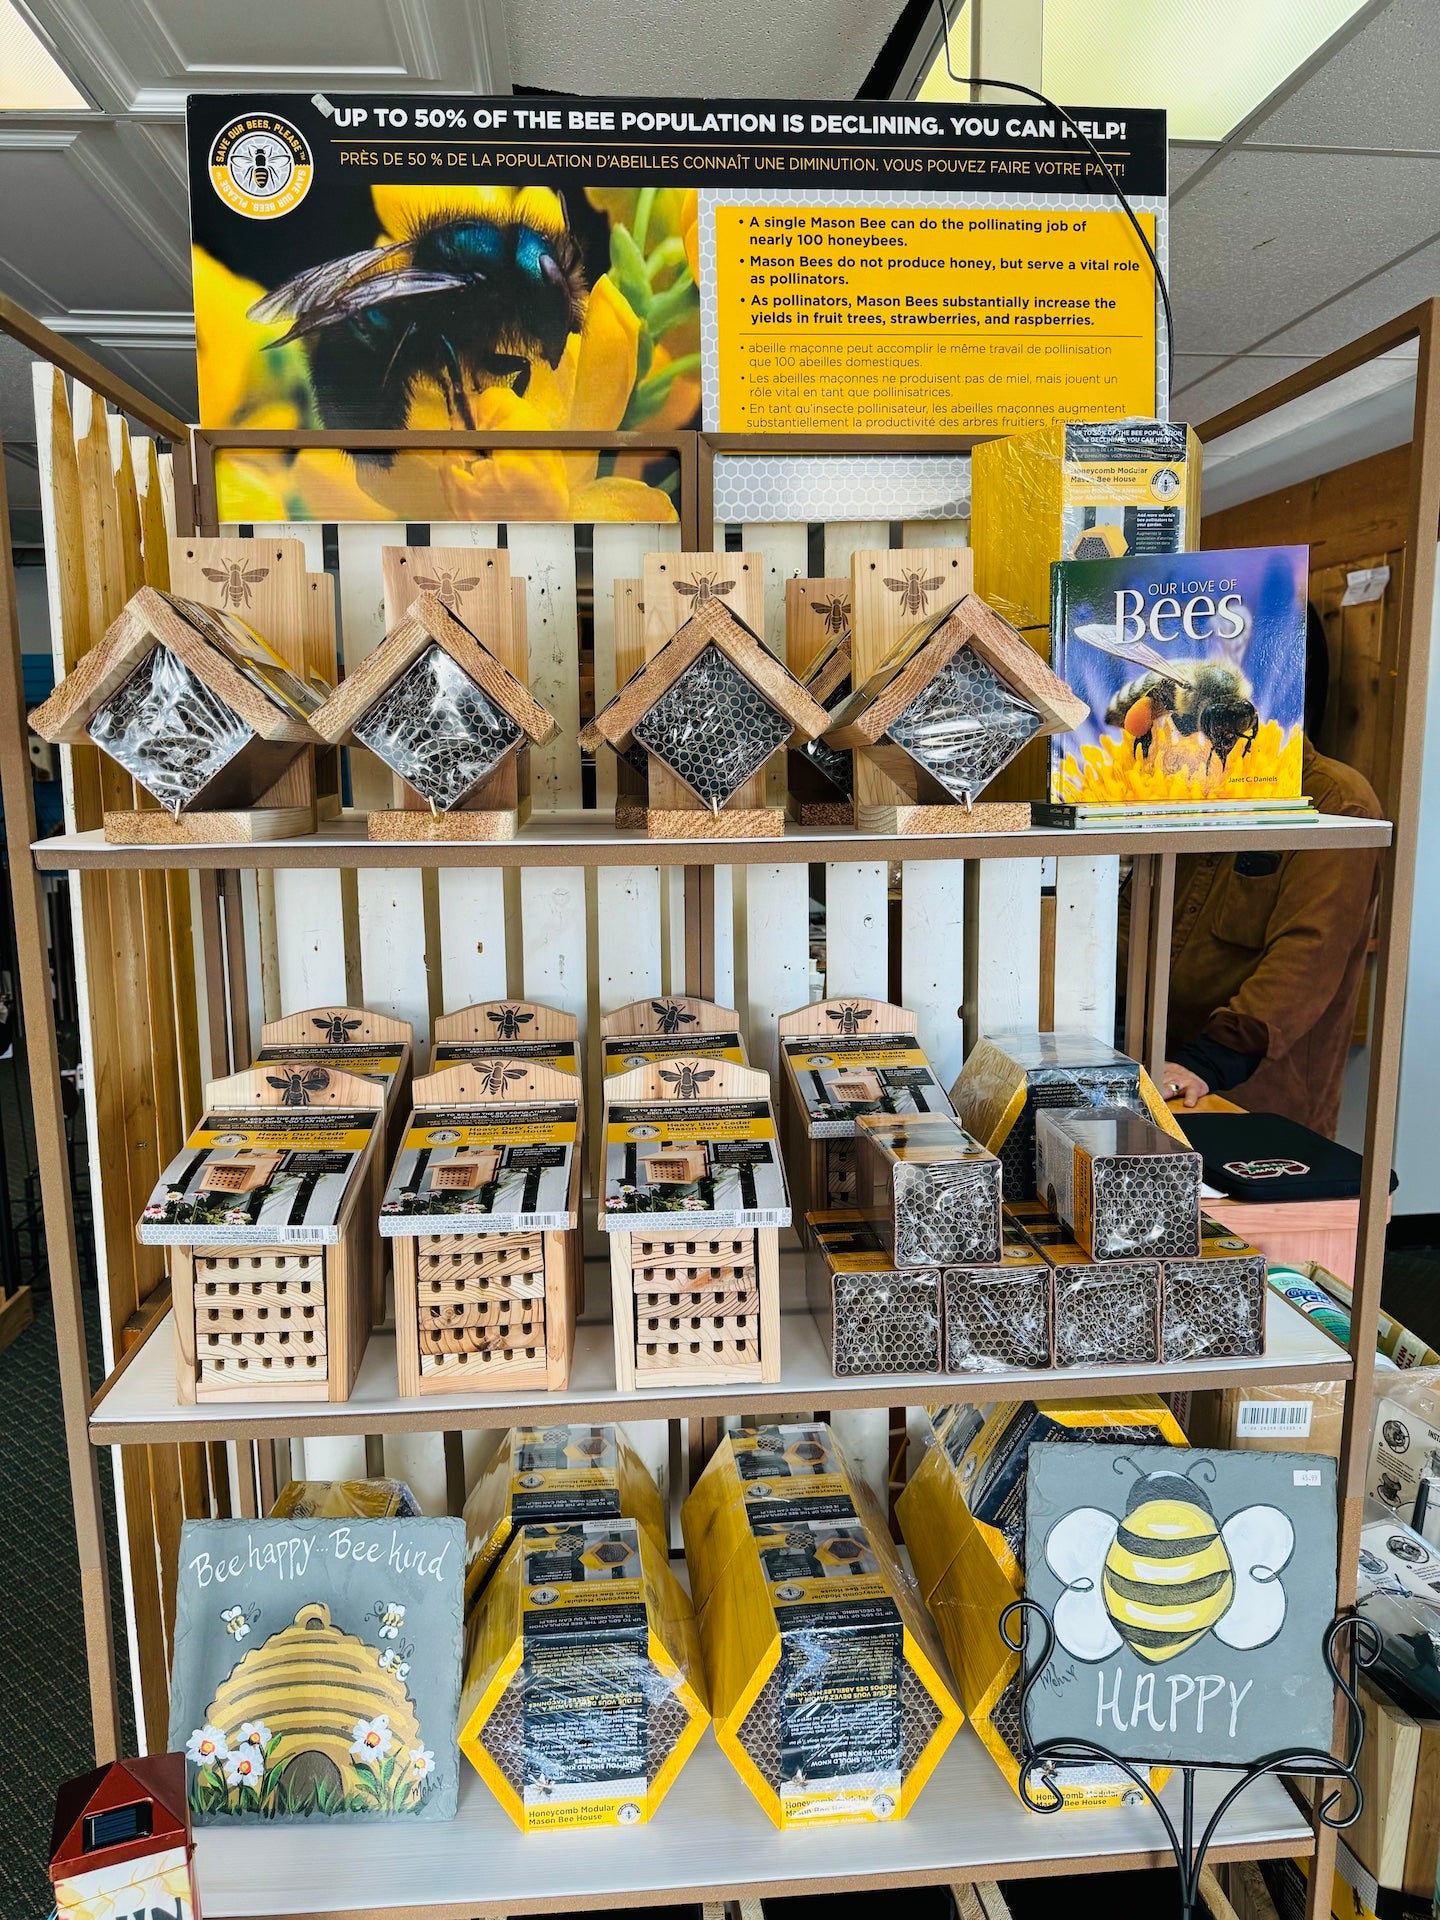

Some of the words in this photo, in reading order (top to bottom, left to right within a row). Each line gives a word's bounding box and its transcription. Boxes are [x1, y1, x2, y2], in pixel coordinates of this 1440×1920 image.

[334, 108, 367, 127] UP
[374, 109, 408, 127] TO
[415, 109, 466, 128] 50%
[474, 110, 507, 128] OF
[514, 111, 562, 129] THE
[569, 112, 614, 130] BEE
[622, 112, 775, 132] POPULATION
[783, 115, 804, 132] IS
[811, 115, 944, 134] DECLINING.
[950, 118, 999, 136] YOU
[1006, 119, 1054, 137] CAN
[1062, 121, 1126, 140] HELP!
[216, 138, 230, 162] SAVE
[228, 124, 245, 139] OUR
[246, 120, 271, 129] BEES.
[341, 150, 378, 165] PRÈS
[384, 152, 403, 165] DE
[408, 153, 426, 165] 50
[431, 153, 442, 166] %
[448, 153, 467, 166] DE
[472, 154, 491, 166] LA
[496, 154, 591, 167] POPULATION
[684, 154, 750, 169] CONNAÎT
[755, 157, 784, 170] UNE
[790, 158, 878, 171] DIMINUTION.
[883, 159, 923, 172] VOUS
[928, 160, 986, 172] POUVEZ
[991, 161, 1030, 174] FAIRE
[1035, 162, 1081, 175] VOTRE
[1085, 163, 1124, 176] PART!
[750, 217, 759, 227] A
[765, 216, 806, 229] single
[812, 218, 854, 228] Mason
[861, 218, 886, 228] Bee
[920, 218, 937, 229] do
[942, 219, 964, 229] the
[969, 219, 1042, 232] pollinating
[1047, 220, 1068, 233] job
[1073, 221, 1086, 231] of
[750, 234, 792, 247] nearly
[798, 235, 822, 245] 100
[828, 234, 907, 248] honeybees.
[751, 256, 794, 266] Mason
[800, 256, 832, 267] Bees
[838, 256, 855, 267] do
[861, 258, 882, 267] not
[888, 257, 944, 269] produce
[950, 258, 995, 270] honey,
[1001, 258, 1022, 268] but
[1028, 261, 1063, 269] serve
[1069, 262, 1075, 270] a
[1081, 260, 1108, 270] vital
[1114, 260, 1139, 271] role
[751, 276, 764, 284] as
[770, 273, 848, 286] pollinators.
[751, 295, 768, 305] As
[774, 295, 851, 308] pollinators,
[857, 296, 900, 306] Mason
[906, 296, 938, 306] Bees
[943, 296, 1029, 309] substantially
[1035, 297, 1090, 308] increase
[1095, 298, 1116, 308] the
[752, 312, 792, 325] yields
[798, 312, 808, 323] in
[814, 312, 842, 323] fruit
[848, 314, 885, 325] trees,
[891, 313, 980, 326] strawberries,
[985, 314, 1009, 324] and
[1015, 314, 1094, 326] raspberries.
[749, 343, 786, 353] abeille
[790, 345, 843, 354] maçonne
[848, 344, 873, 354] peut
[877, 344, 933, 354] accomplir
[938, 344, 946, 353] le
[951, 344, 986, 353] même
[990, 344, 1023, 354] travail
[1027, 344, 1041, 354] de
[1045, 344, 1111, 355] pollinisation
[750, 359, 771, 368] que
[775, 357, 795, 366] 100
[799, 357, 842, 366] abeilles
[846, 357, 922, 368] domestiques.
[750, 374, 769, 383] Les
[773, 373, 815, 383] abeilles
[820, 376, 878, 384] maçonnes
[900, 373, 960, 384] produisent
[965, 376, 984, 384] pas
[988, 374, 1002, 383] de
[1006, 374, 1031, 384] miel,
[1036, 374, 1061, 383] mais
[1065, 374, 1100, 385] jouent
[1104, 376, 1117, 384] un
[750, 387, 772, 397] rôle
[776, 387, 799, 397] vital
[804, 389, 817, 397] en
[822, 388, 844, 397] tant
[848, 390, 869, 398] que
[874, 387, 953, 398] pollinisatrices.
[750, 404, 764, 413] En
[769, 404, 791, 413] tant
[858, 404, 928, 415] pollinisateur,
[932, 404, 947, 413] les
[951, 403, 993, 413] abeilles
[997, 406, 1054, 414] maçonnes
[1058, 404, 1126, 414] augmentent
[747, 417, 848, 428] substantiellement
[853, 417, 862, 427] la
[866, 417, 935, 429] productivité
[938, 417, 959, 427] des
[962, 417, 998, 426] arbres
[1002, 416, 1047, 428] fruitiers,
[1148, 582, 1177, 595] OUR
[1182, 580, 1214, 594] LOVE
[1219, 579, 1237, 591] OF
[1114, 590, 1244, 644] Bees
[189, 1552, 246, 1588] Bee
[329, 1528, 387, 1562] Bee
[388, 1530, 450, 1582] kind
[1096, 1667, 1253, 1737] HAPPY
[529, 1808, 578, 1817] Honeycomb
[529, 1817, 555, 1825] Mason
